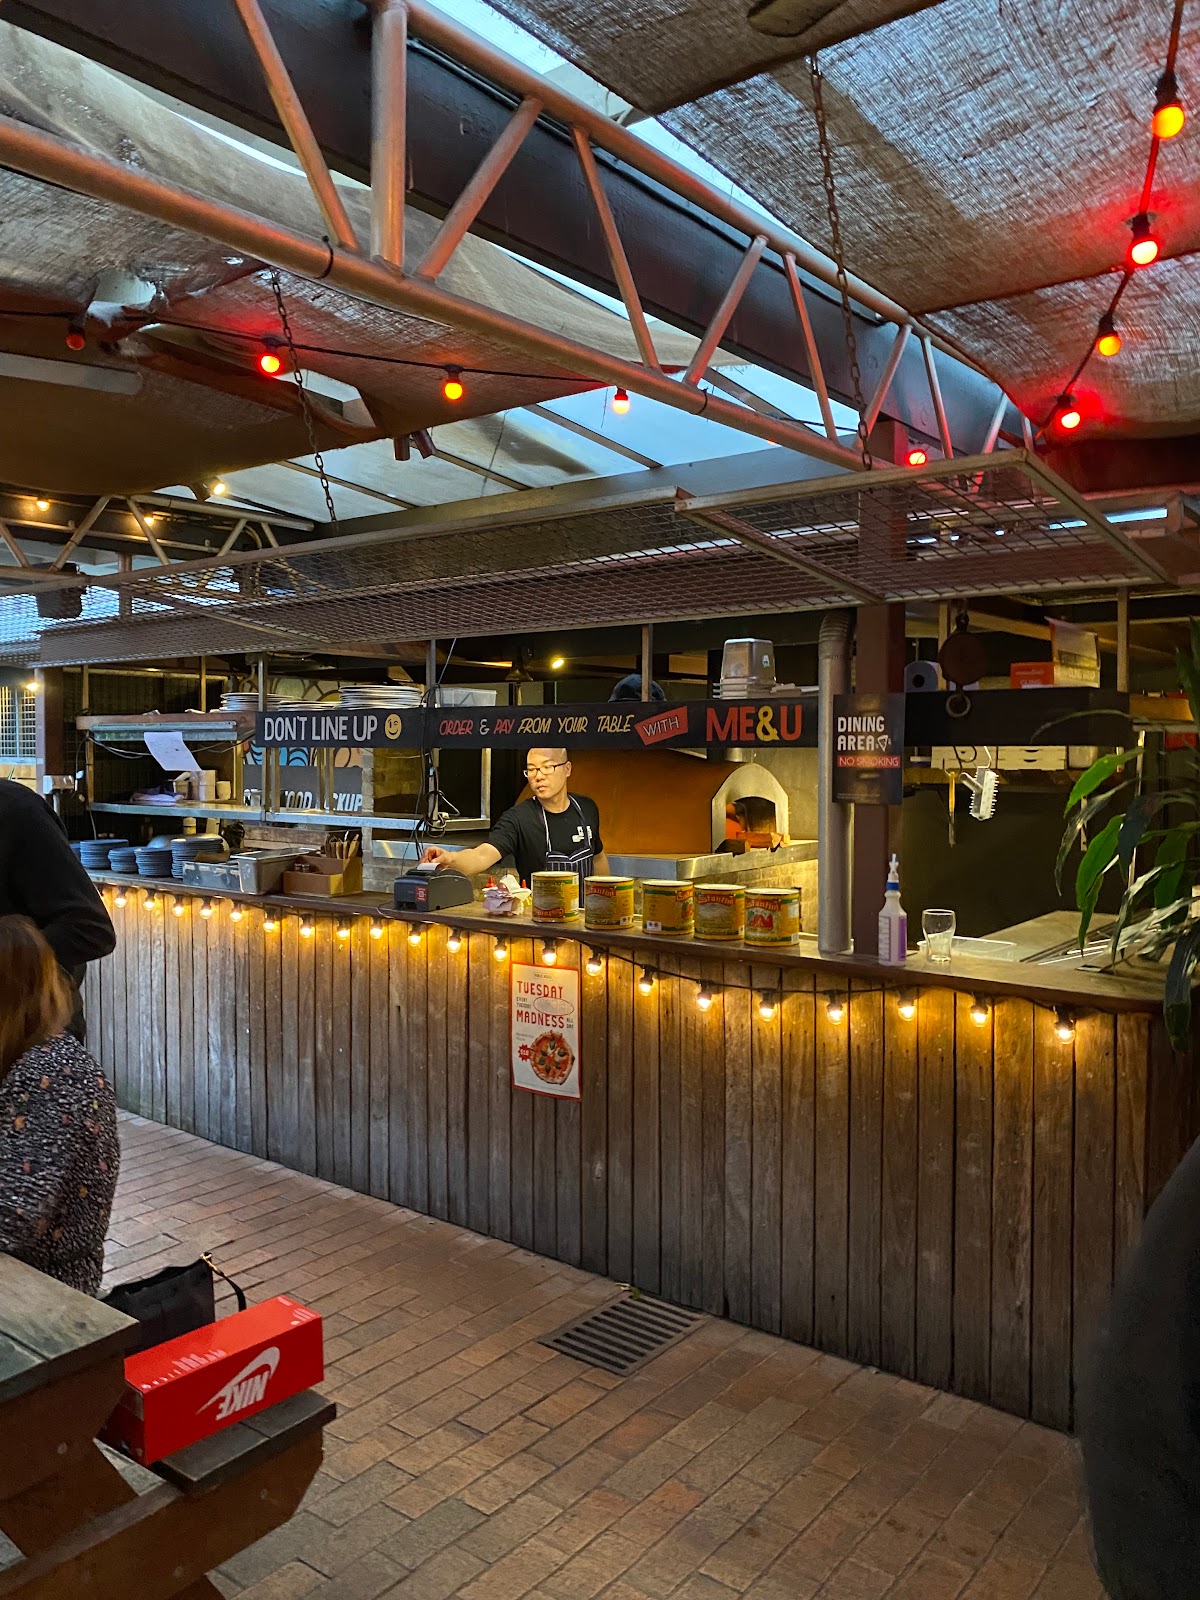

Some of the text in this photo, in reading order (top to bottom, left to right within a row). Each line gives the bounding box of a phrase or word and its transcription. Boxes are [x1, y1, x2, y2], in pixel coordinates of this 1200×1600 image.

[264, 714, 378, 742] DON'T LINE UP
[439, 714, 635, 736] ORDER & PAY FROM YOUR TABLE
[642, 715, 680, 738] WITH
[706, 704, 803, 742] ME&U
[837, 715, 885, 733] DINING
[837, 734, 875, 751] AREA
[839, 756, 899, 767] NO SMOKING
[284, 790, 313, 810] OOD
[516, 980, 564, 1000] TUESDAY
[516, 1009, 565, 1029] MADNESS
[215, 1370, 269, 1421] NIKE
